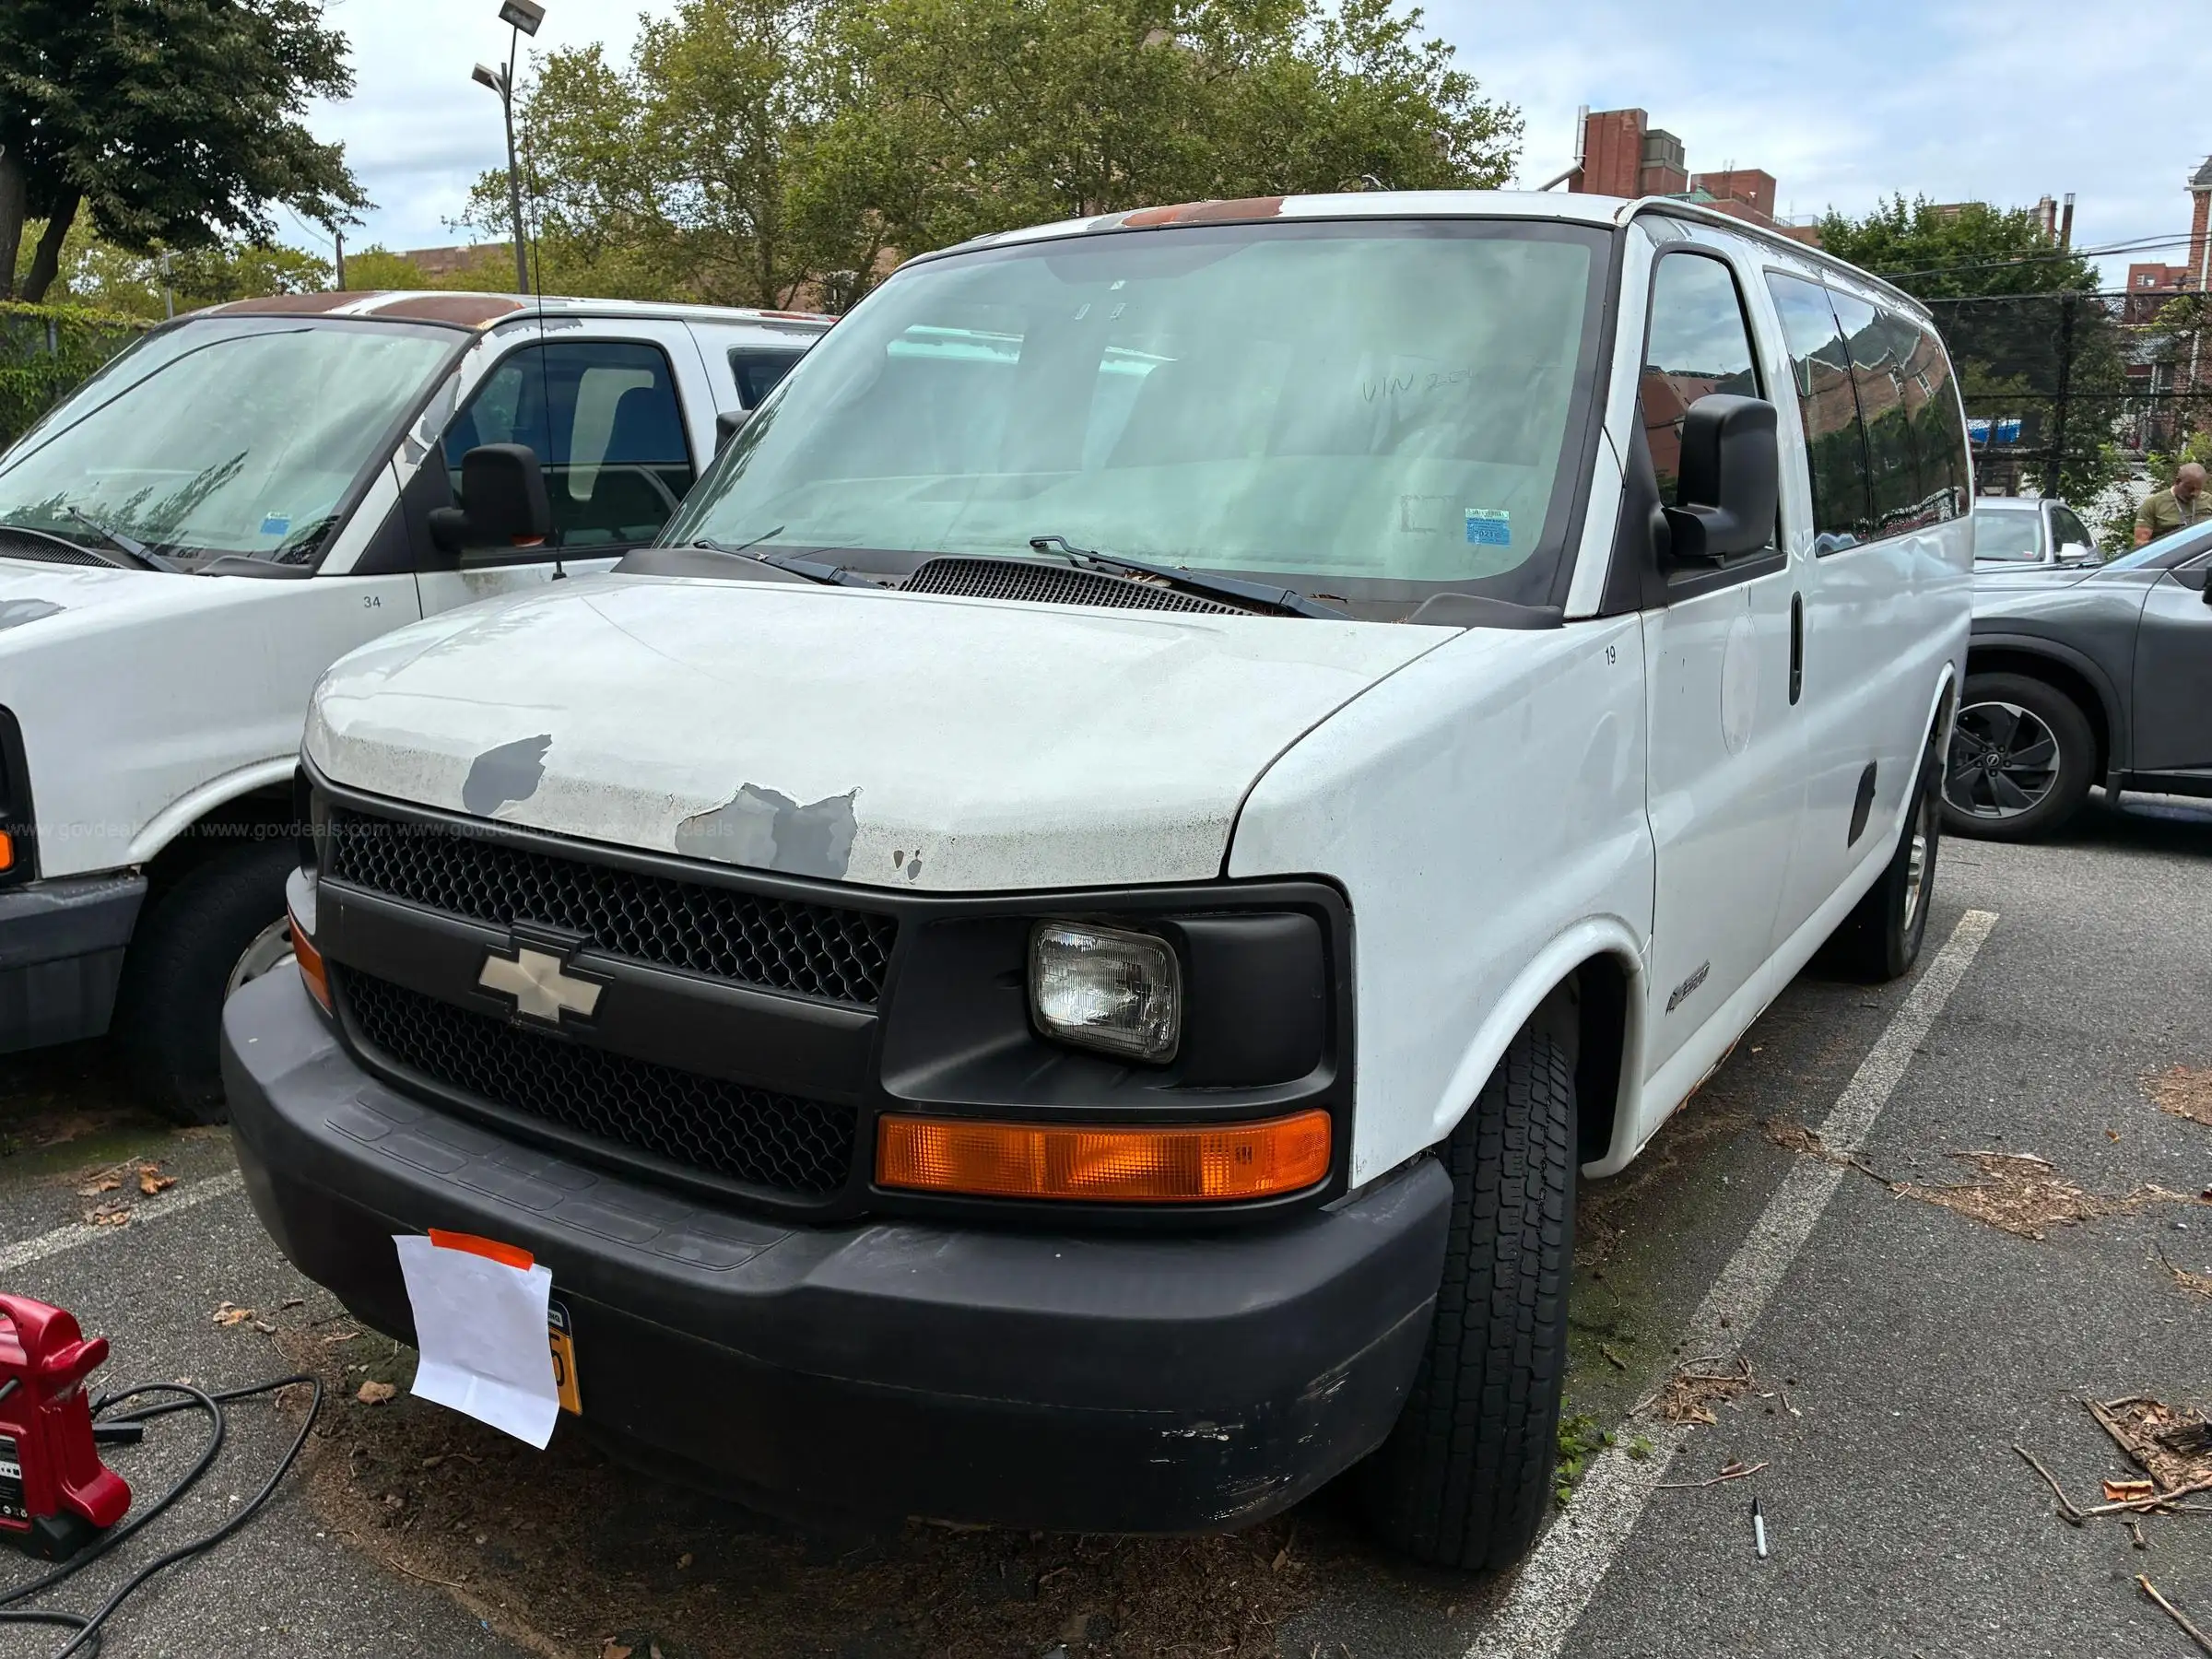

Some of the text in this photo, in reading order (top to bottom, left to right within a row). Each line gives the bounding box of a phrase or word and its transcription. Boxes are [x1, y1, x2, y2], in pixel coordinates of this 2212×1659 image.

[1363, 373, 1414, 403] VIN
[364, 595, 381, 608] 34
[1606, 645, 1616, 665] 19
